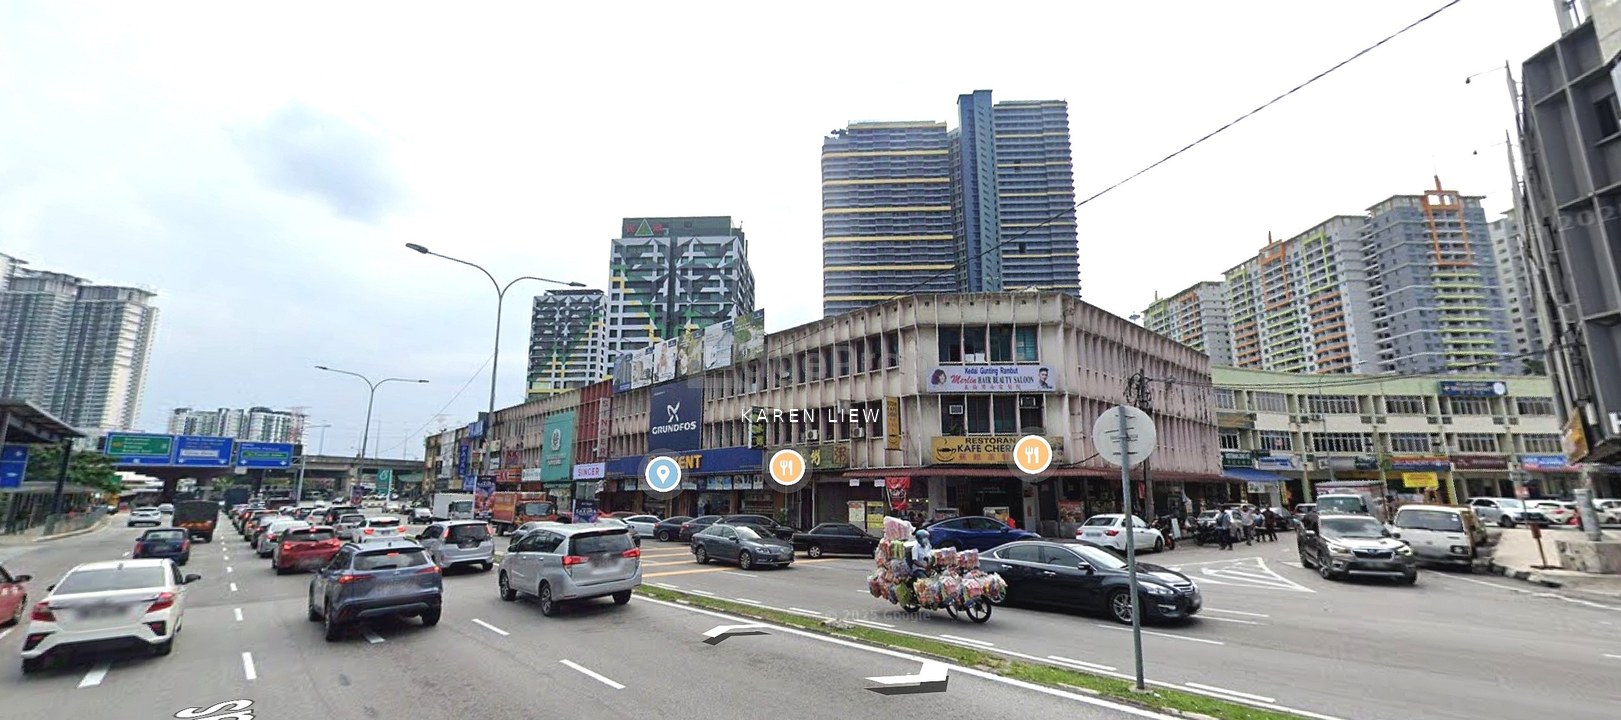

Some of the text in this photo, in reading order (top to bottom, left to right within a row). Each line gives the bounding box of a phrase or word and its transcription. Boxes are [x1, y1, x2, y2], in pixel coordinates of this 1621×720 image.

[965, 367, 1018, 376] Kedai Gunting Rambut
[951, 375, 1034, 385] Merlin HAIR BEAUTY SALOON
[599, 399, 609, 456] SINGER
[652, 420, 697, 435] GRUNDFOS
[957, 444, 1014, 453] KAFE CHER
[577, 467, 600, 477] SINGER
